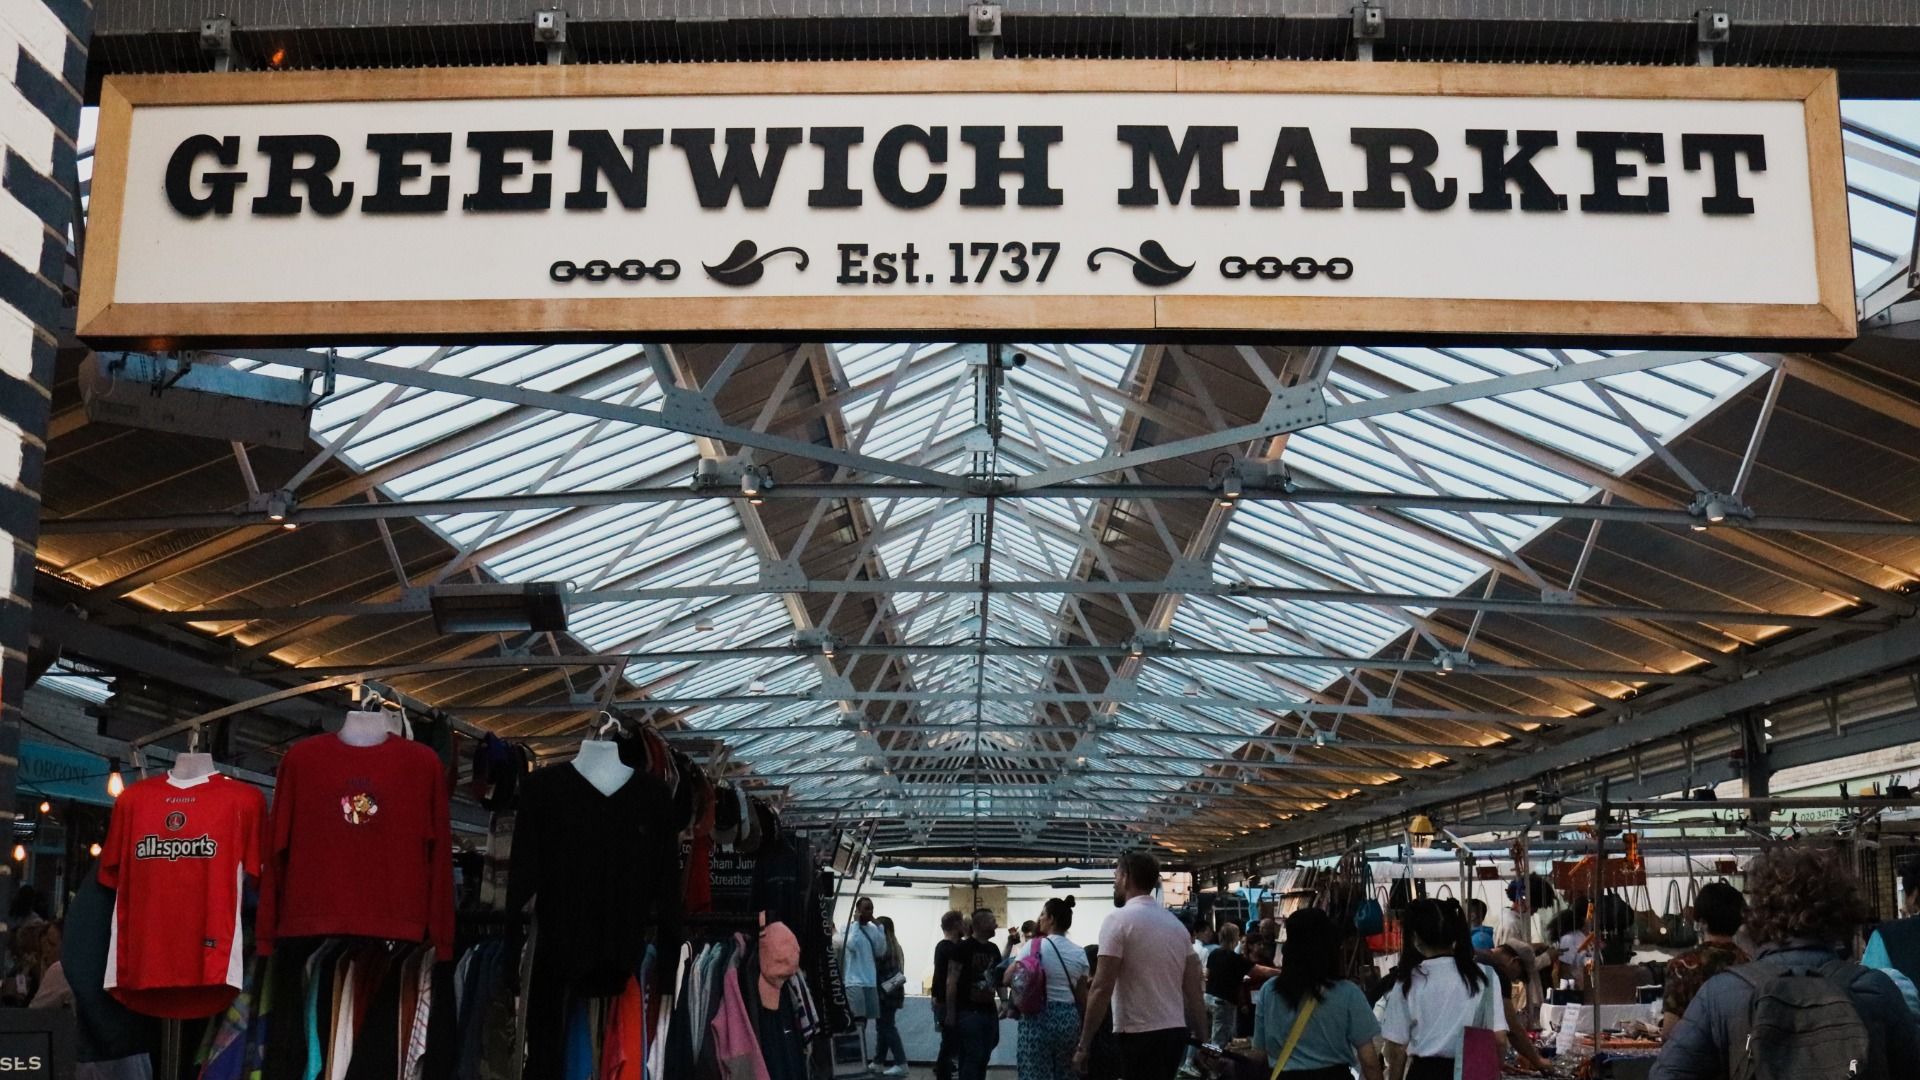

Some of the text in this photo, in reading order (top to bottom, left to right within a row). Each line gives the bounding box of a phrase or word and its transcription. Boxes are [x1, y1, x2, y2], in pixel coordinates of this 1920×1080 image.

[166, 125, 1767, 218] GREENWICH MARKET
[837, 242, 1061, 284] Est. 1737
[137, 835, 216, 860] all:sports
[827, 944, 846, 1005] CHARING
